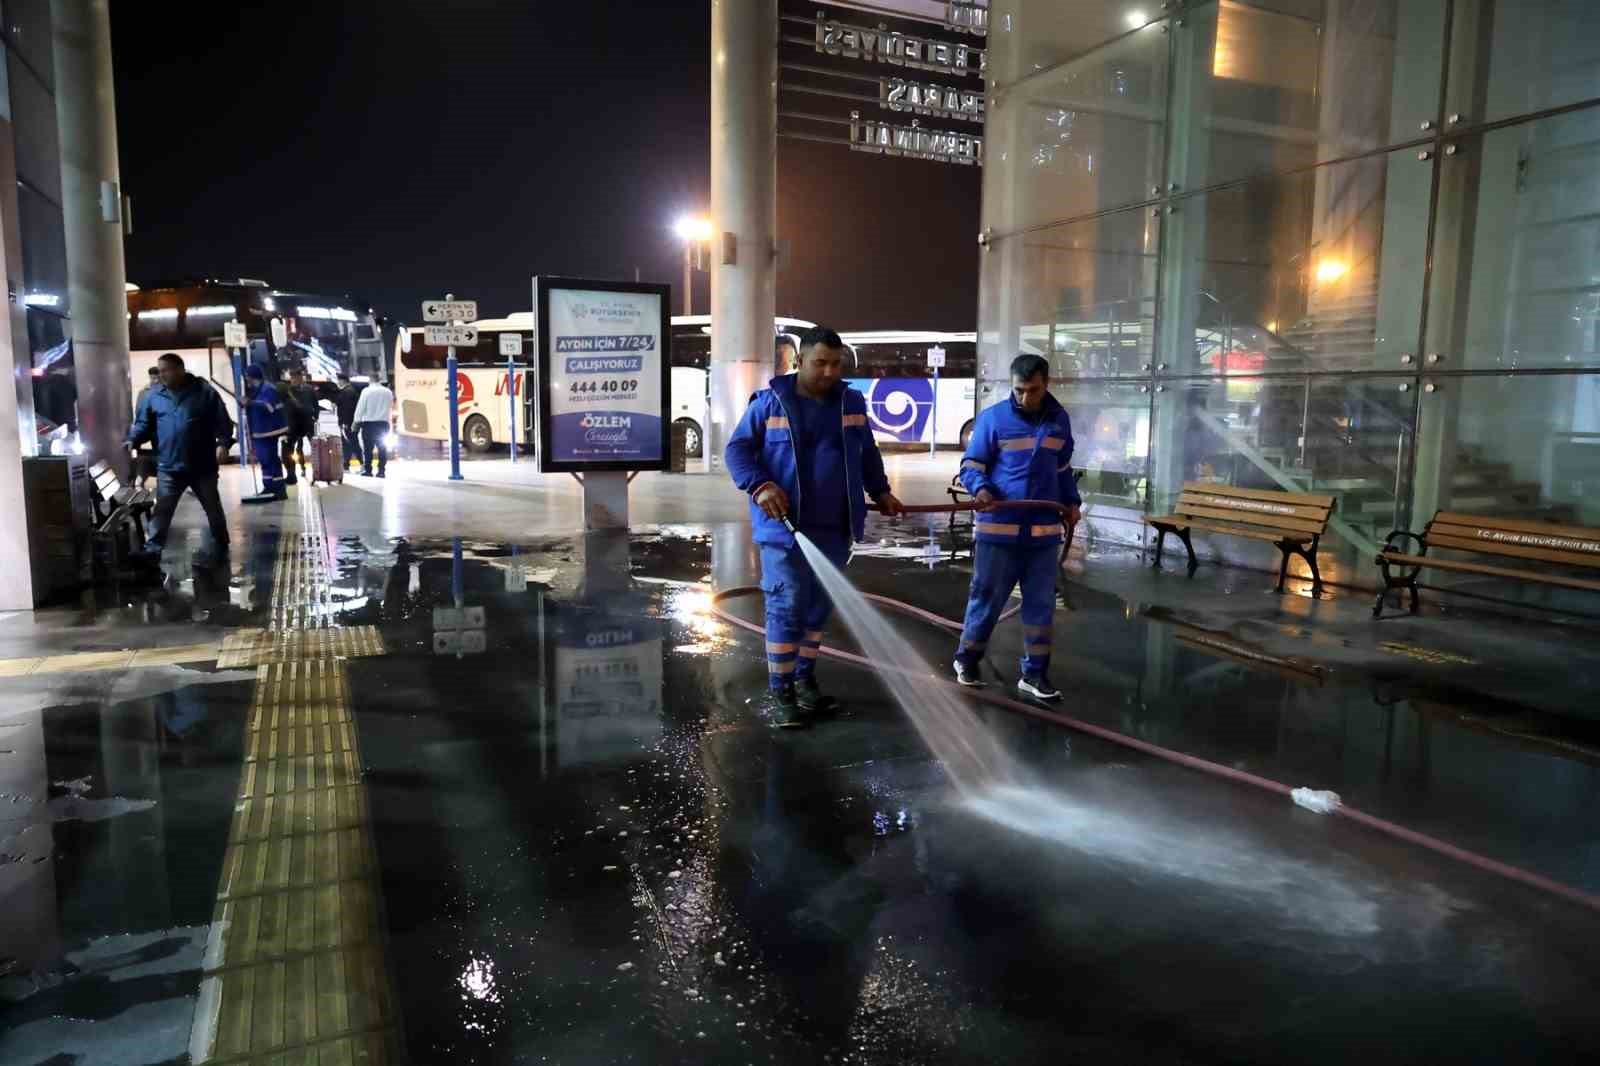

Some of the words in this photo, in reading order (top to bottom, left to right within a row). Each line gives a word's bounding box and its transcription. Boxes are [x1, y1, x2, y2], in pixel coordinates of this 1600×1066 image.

[558, 338, 592, 349] AYDIN
[594, 335, 616, 350] İÇİN
[569, 359, 638, 374] ÇALIŞIYORUZ
[570, 381, 597, 393] 444
[601, 380, 618, 392] 40
[621, 379, 639, 392] 09
[585, 412, 632, 428] ÖZLEM
